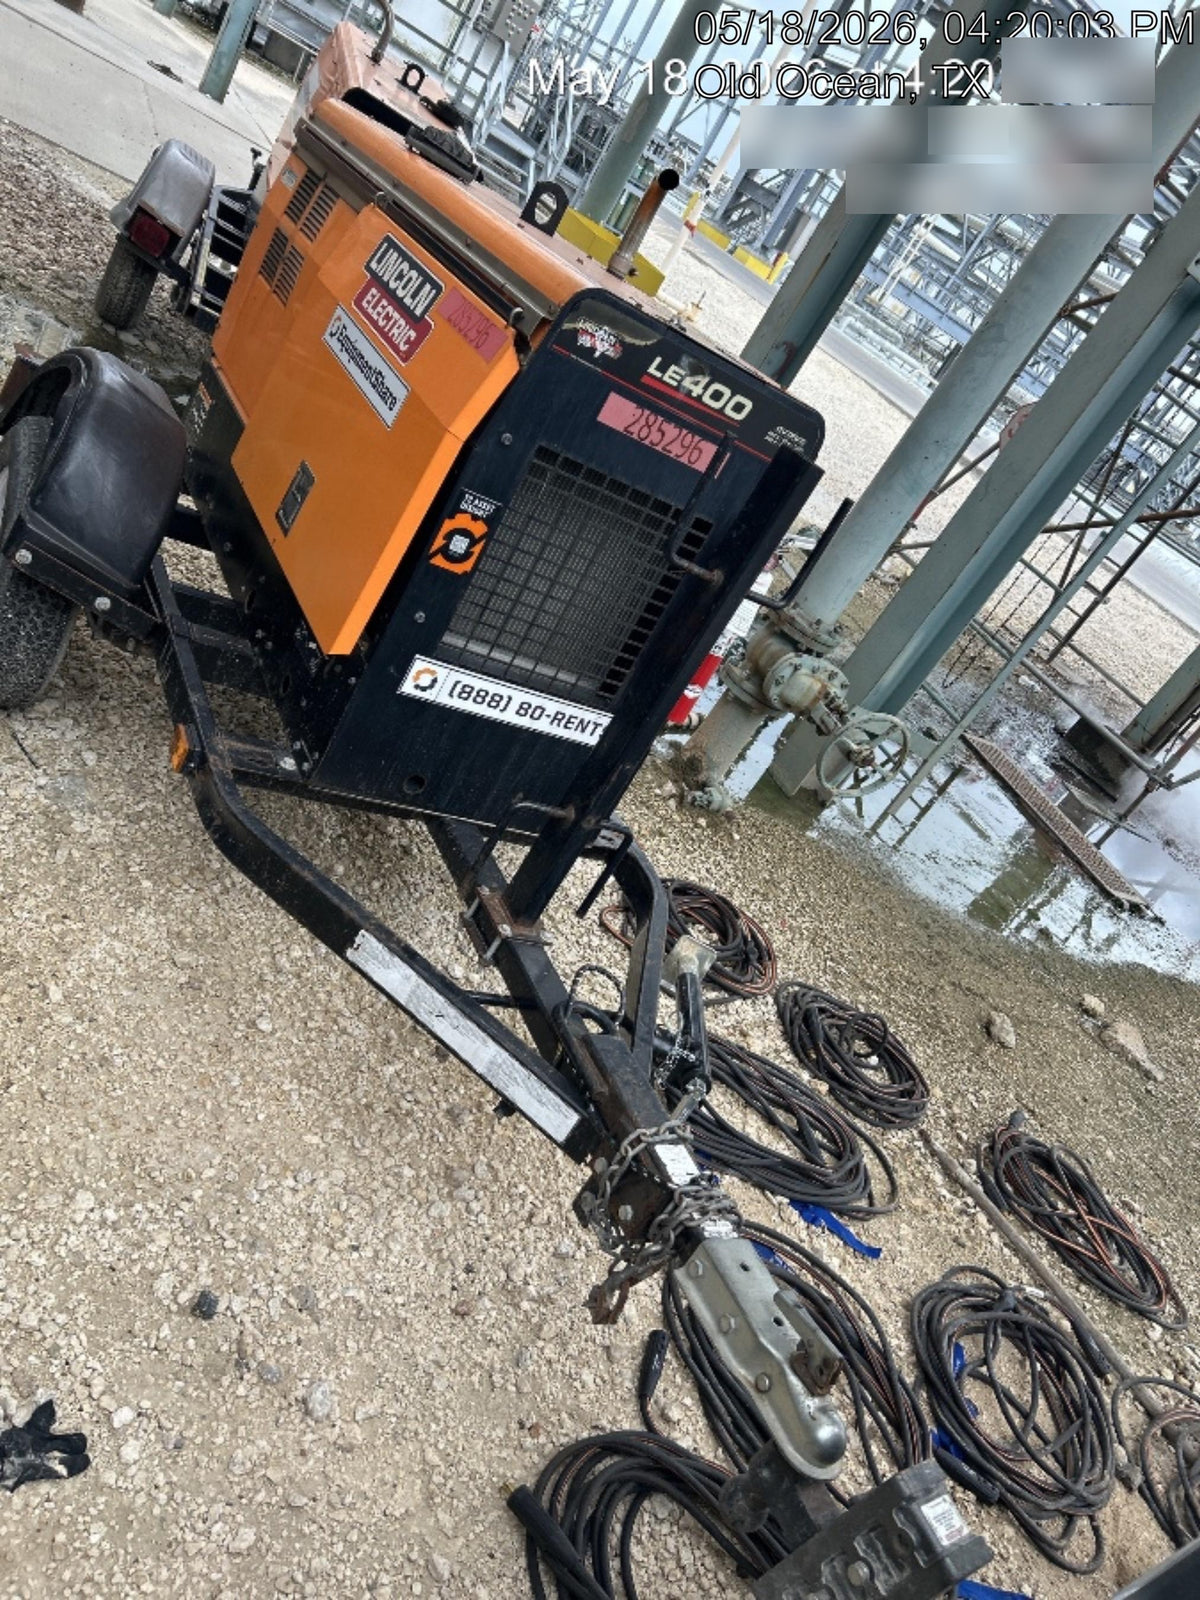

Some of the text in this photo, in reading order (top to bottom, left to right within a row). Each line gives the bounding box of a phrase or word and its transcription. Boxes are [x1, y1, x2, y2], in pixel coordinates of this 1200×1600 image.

[368, 242, 436, 318] LINCOLN
[361, 287, 417, 352] ELECTRIC
[336, 322, 398, 412] EquipmentShare
[646, 356, 754, 421] LE400
[622, 405, 705, 466] 285296
[447, 679, 603, 738] (888) 80-RENT
